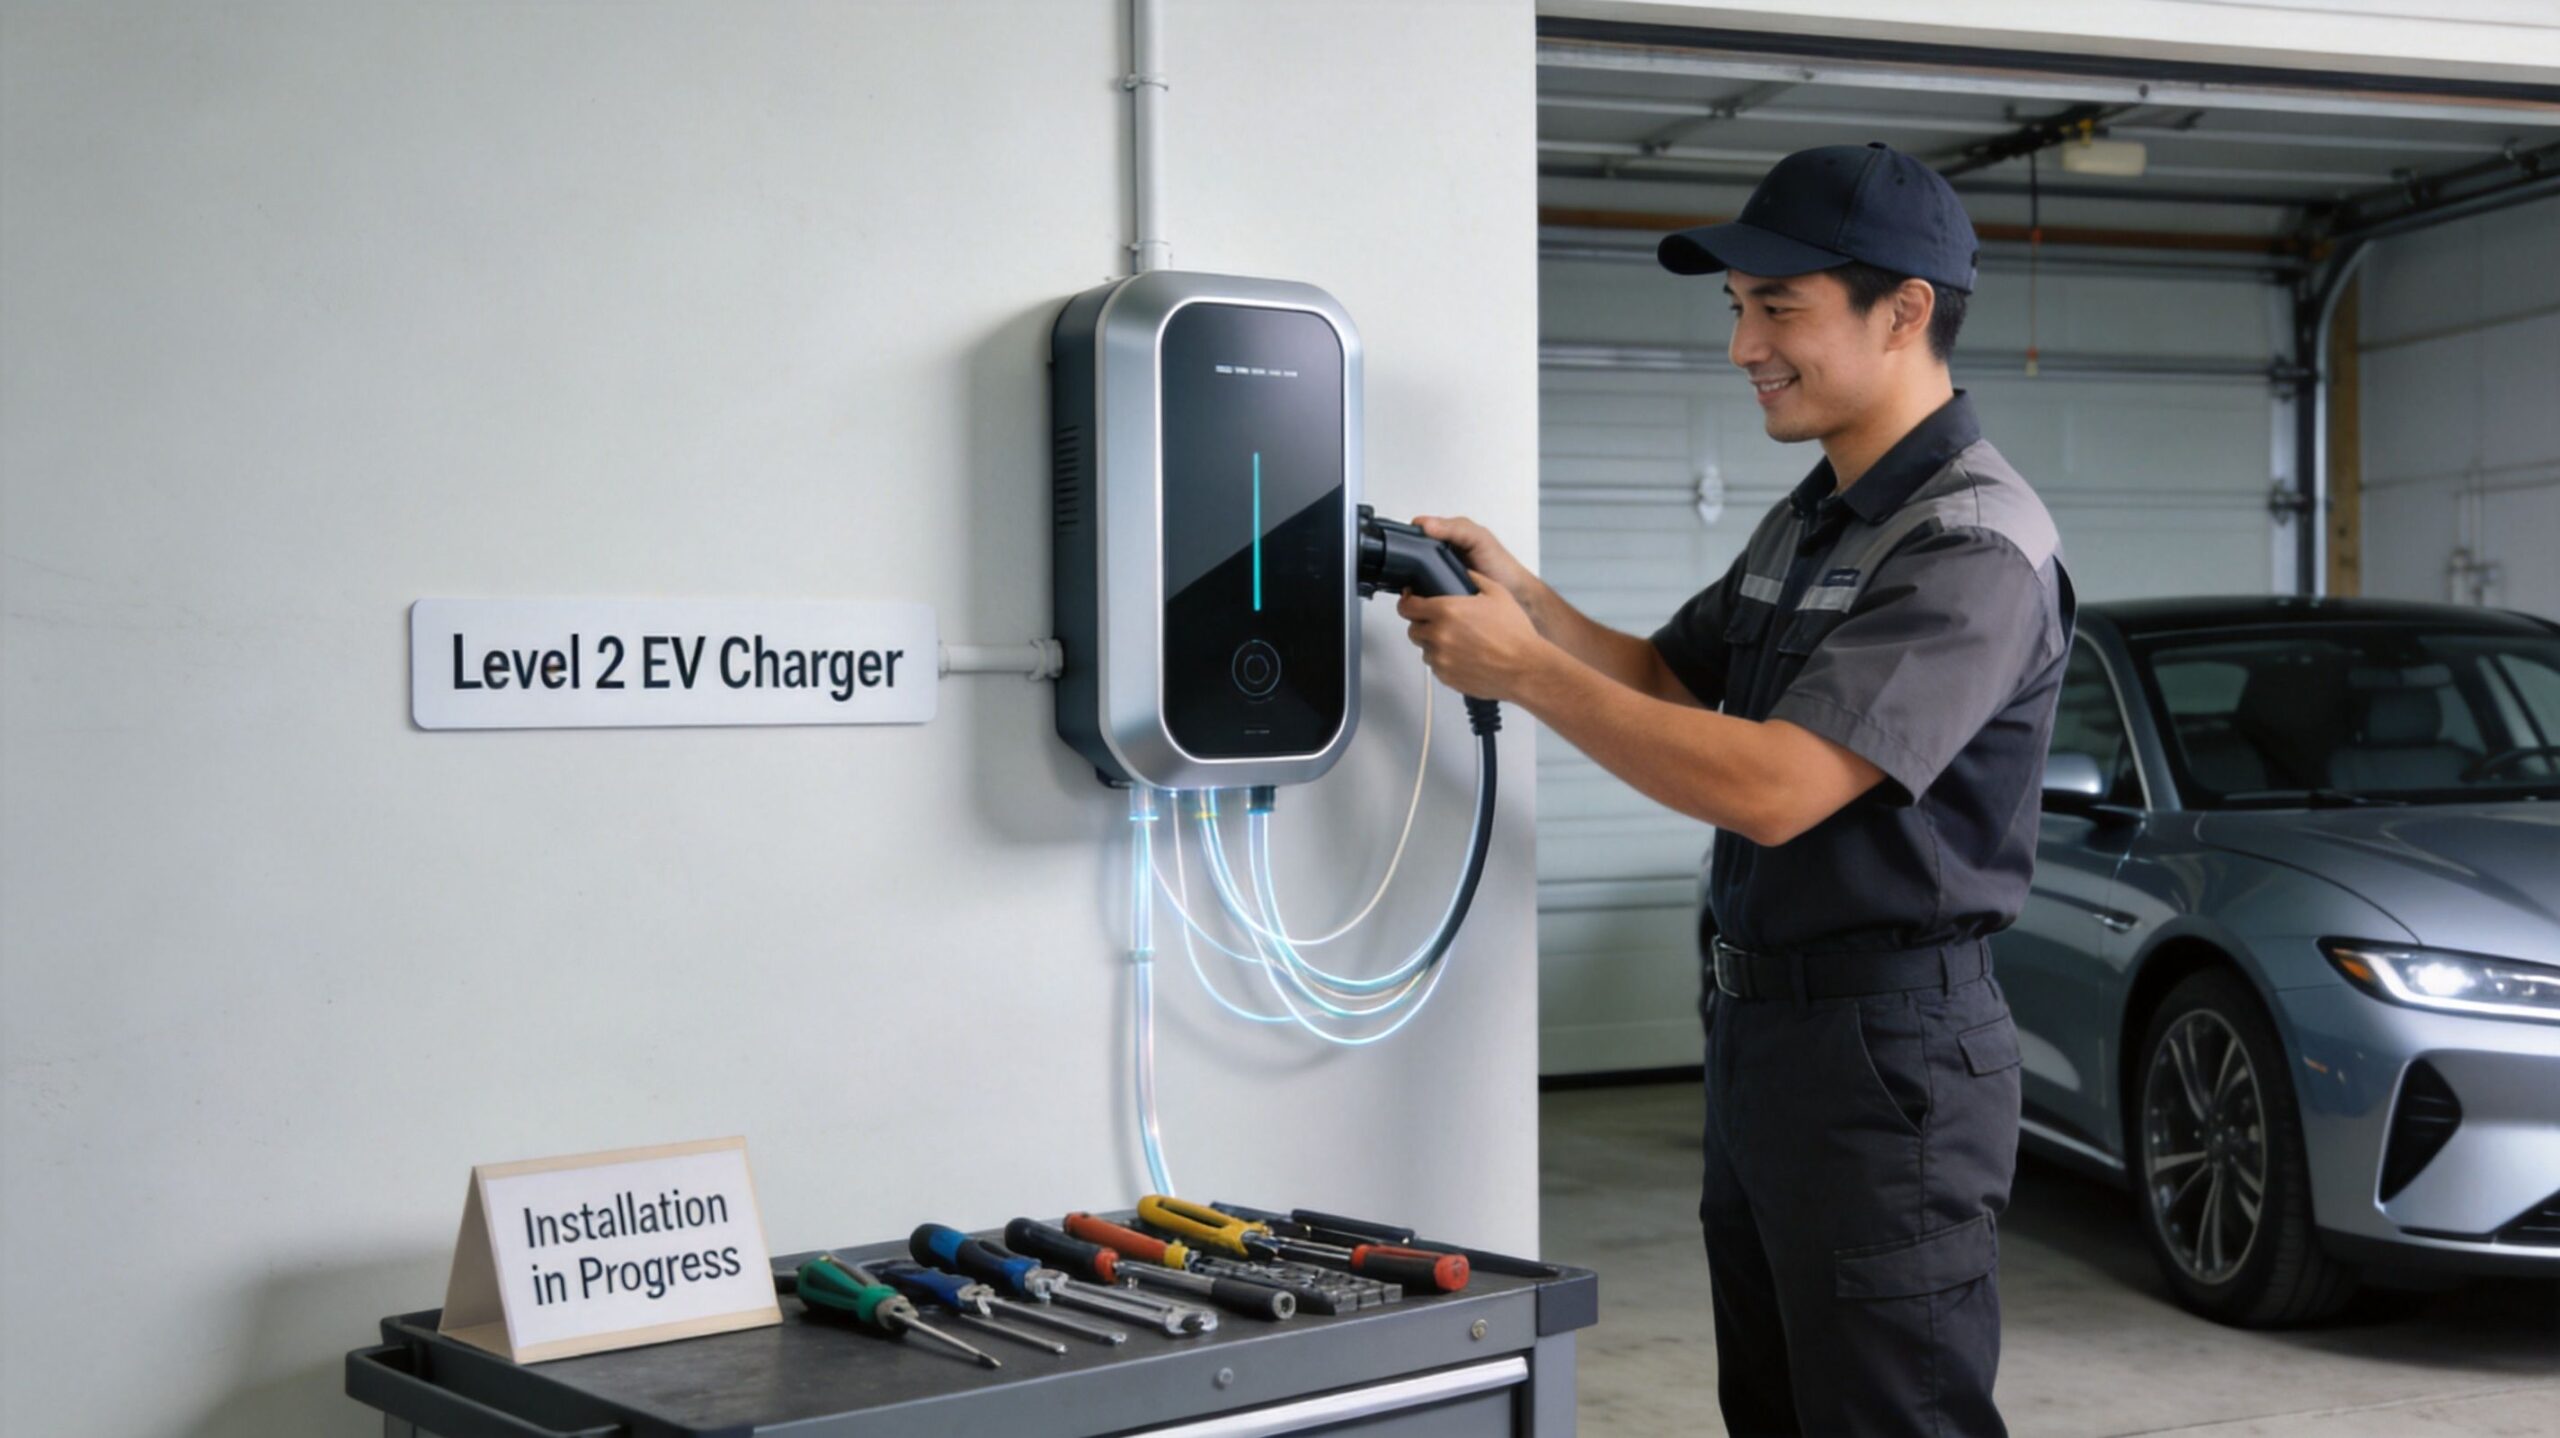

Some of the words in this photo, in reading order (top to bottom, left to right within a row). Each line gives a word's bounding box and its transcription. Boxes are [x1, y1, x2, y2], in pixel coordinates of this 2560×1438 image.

[453, 633, 581, 691] Level
[595, 635, 625, 690] 2
[642, 635, 706, 690] EV
[719, 635, 904, 702] Charger
[523, 1189, 728, 1249] Installation
[531, 1264, 567, 1306] in
[578, 1246, 741, 1300] Progress
